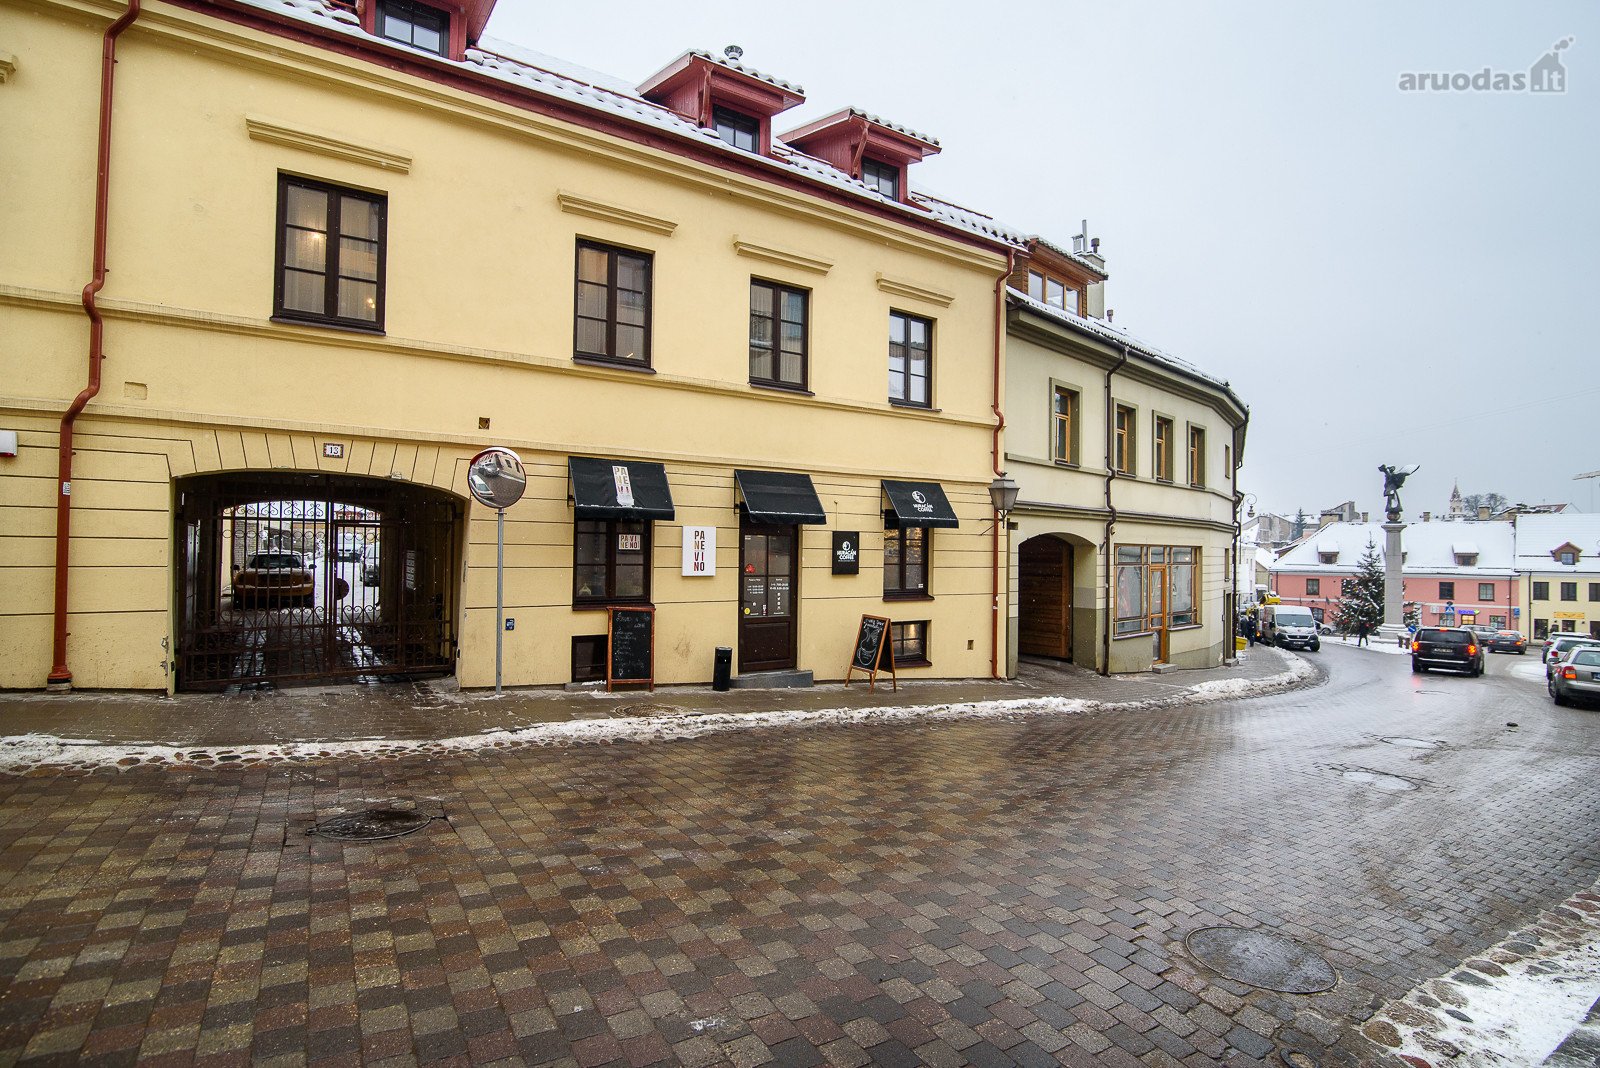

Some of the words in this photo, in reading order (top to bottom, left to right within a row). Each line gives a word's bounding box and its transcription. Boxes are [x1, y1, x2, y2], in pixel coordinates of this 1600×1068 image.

[330, 446, 339, 454] 13
[614, 467, 627, 475] PA
[694, 530, 705, 540] PA
[630, 541, 638, 549] NO
[694, 540, 706, 550] NE
[694, 551, 704, 561] VI
[693, 561, 705, 571] NO
